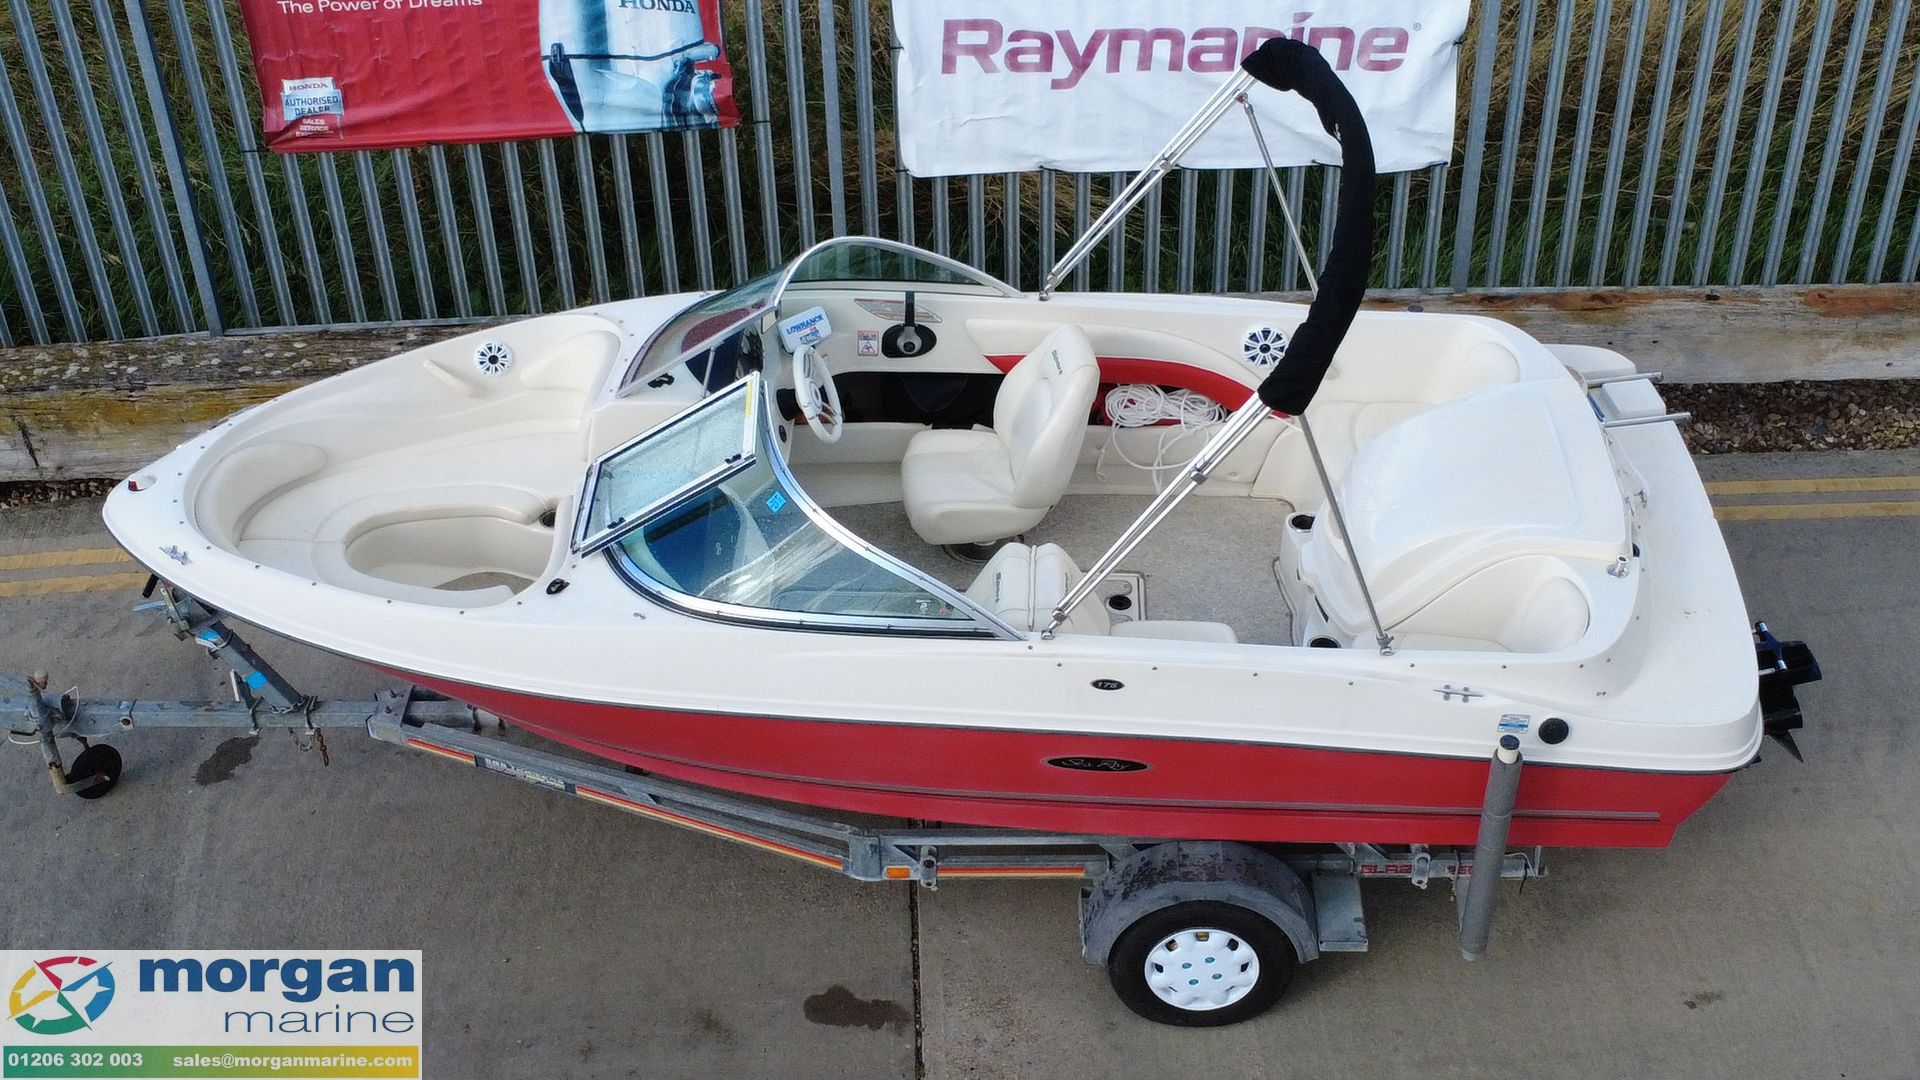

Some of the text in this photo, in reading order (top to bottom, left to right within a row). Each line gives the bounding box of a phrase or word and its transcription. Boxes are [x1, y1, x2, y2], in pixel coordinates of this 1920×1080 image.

[277, 0, 483, 14] The Power of Dreams
[619, 0, 696, 14] HONDA
[289, 83, 328, 91] HONDA
[285, 96, 339, 107] AUTHORISED
[294, 106, 330, 116] DEALER
[786, 314, 824, 335] LOWRANCE
[1097, 681, 1118, 689] 175
